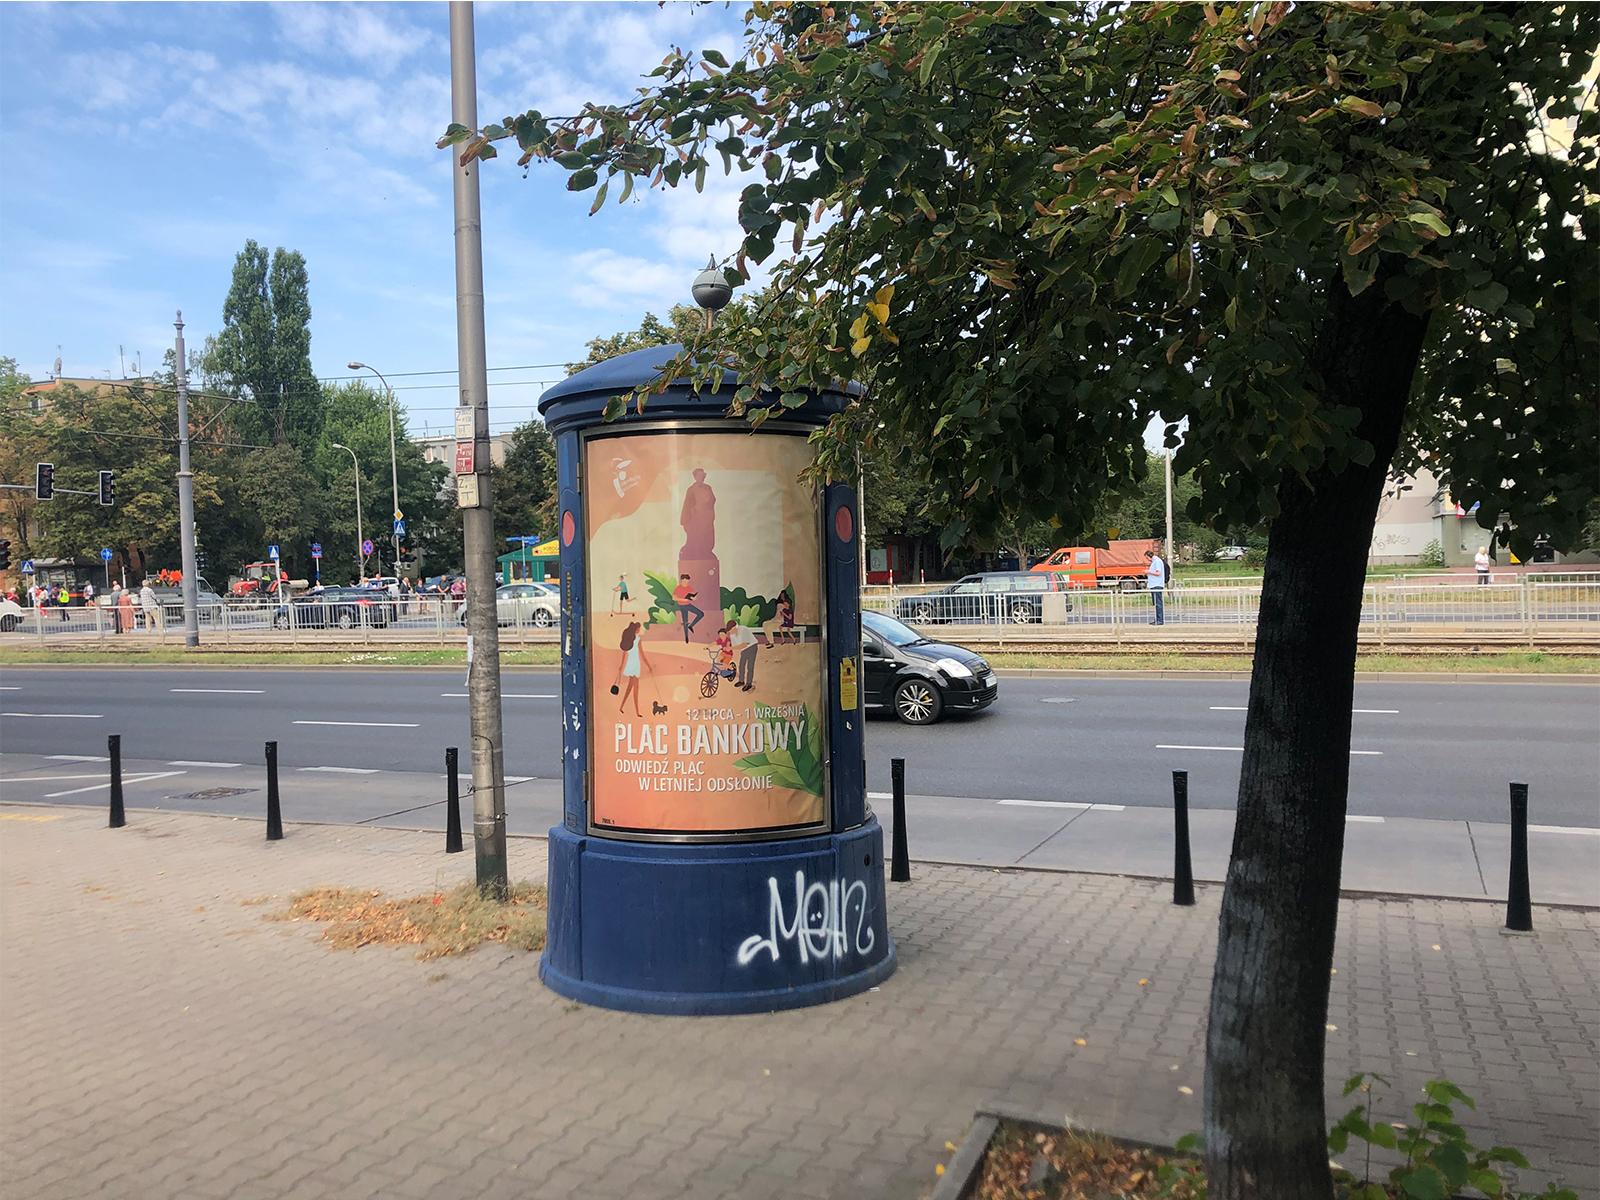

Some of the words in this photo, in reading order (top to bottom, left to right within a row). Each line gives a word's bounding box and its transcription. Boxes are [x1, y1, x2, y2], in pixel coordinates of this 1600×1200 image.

[687, 708, 699, 720] 12
[703, 707, 734, 720] LIPCA
[745, 708, 750, 719] 1
[754, 704, 805, 719] WRZEŚNIA
[615, 722, 668, 754] PLAC
[677, 720, 806, 755] BANKOWY
[615, 758, 669, 775] ODWIEDŹ
[673, 760, 705, 775] PLAC
[639, 777, 651, 791] W
[654, 777, 702, 792] LETNIEJ
[707, 776, 773, 792] ODSŁONIE
